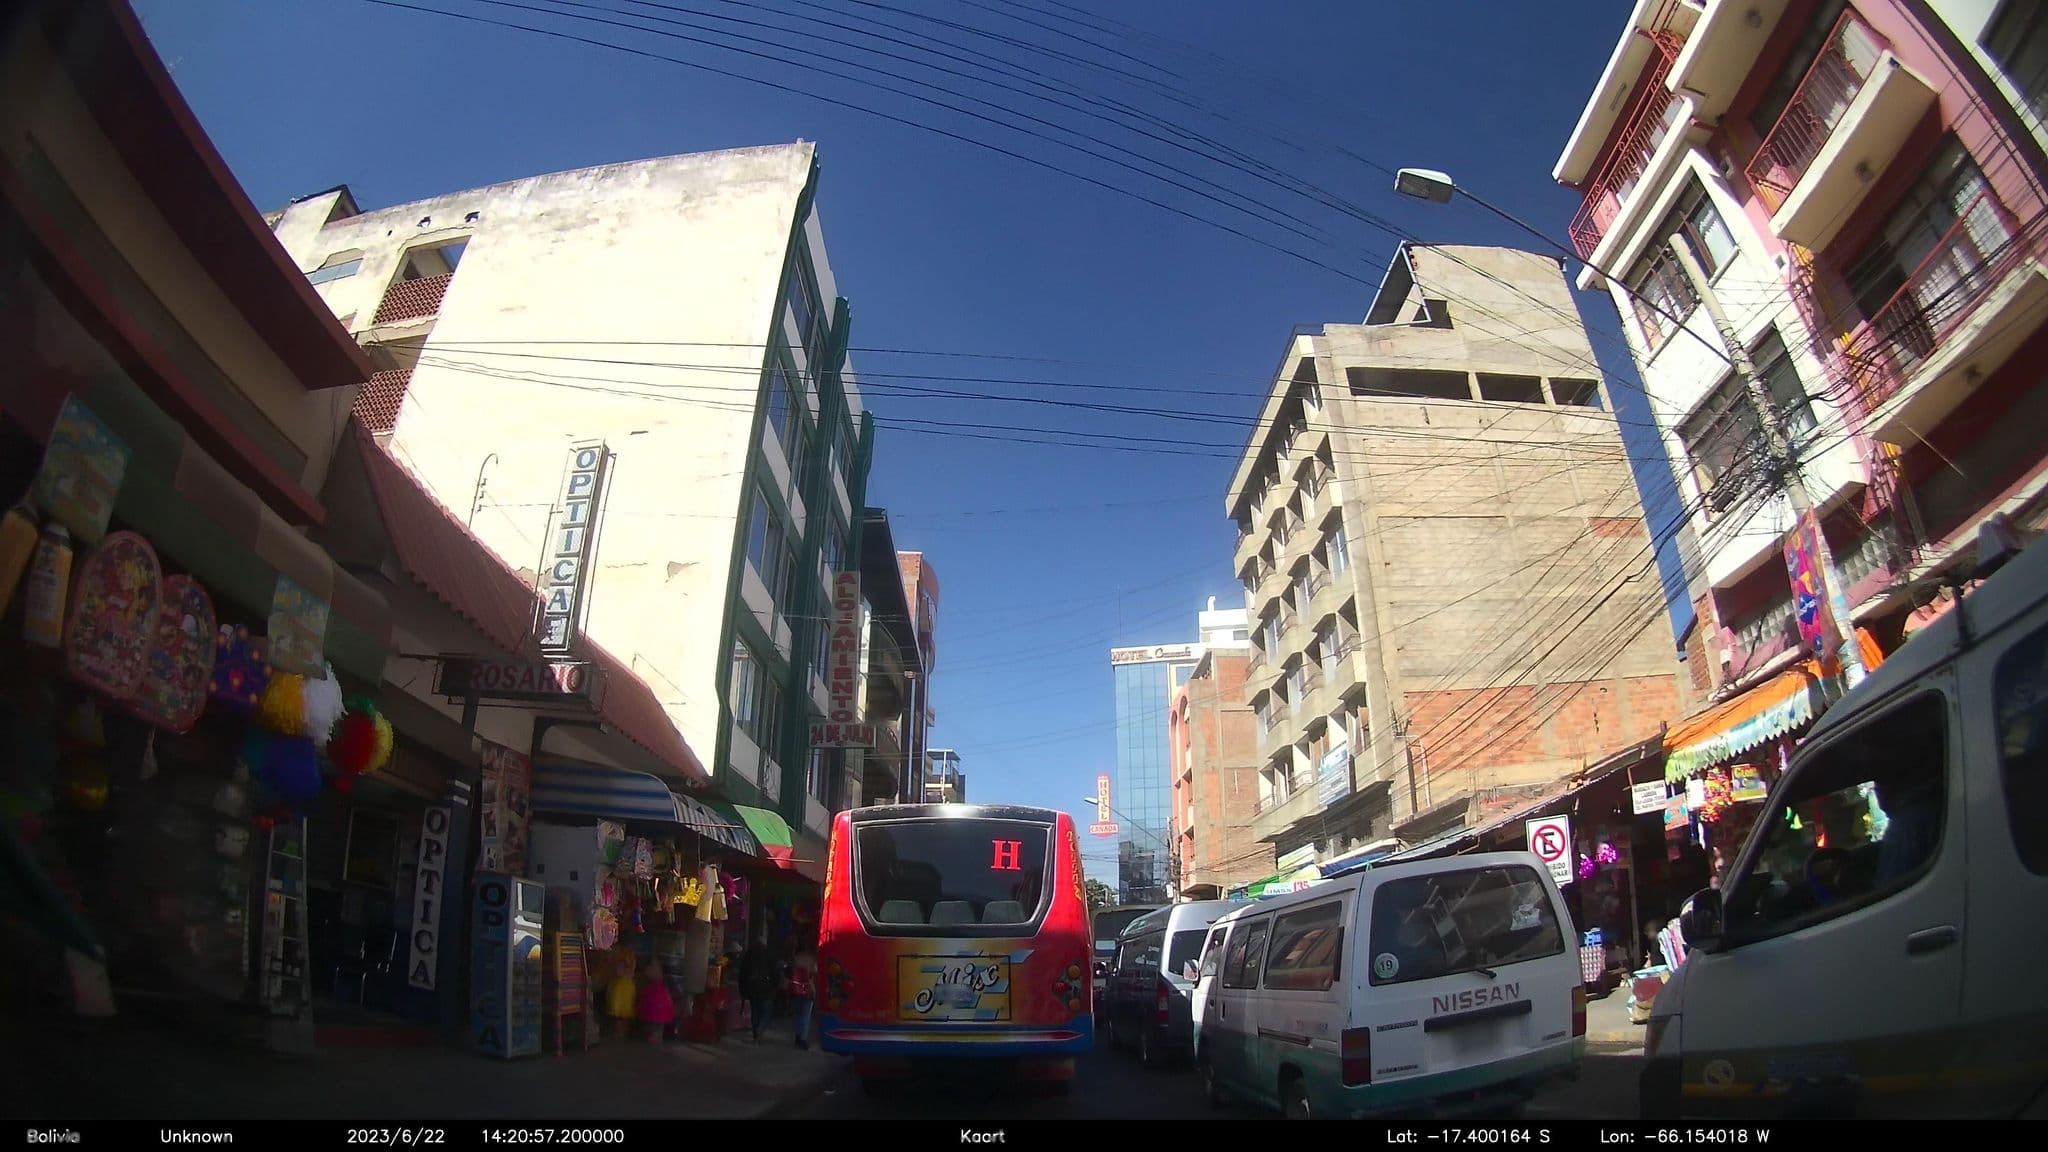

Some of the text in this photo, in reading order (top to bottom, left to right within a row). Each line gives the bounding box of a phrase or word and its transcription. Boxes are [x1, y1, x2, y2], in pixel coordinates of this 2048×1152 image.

[830, 572, 856, 723] ALOJAMIENTO
[1099, 781, 1108, 820] HOTEL
[1090, 824, 1117, 834] CANADA
[990, 839, 1022, 870] H
[410, 808, 448, 986] OPTICA
[1379, 959, 1394, 971] 19
[1432, 982, 1521, 1014] NISSAN
